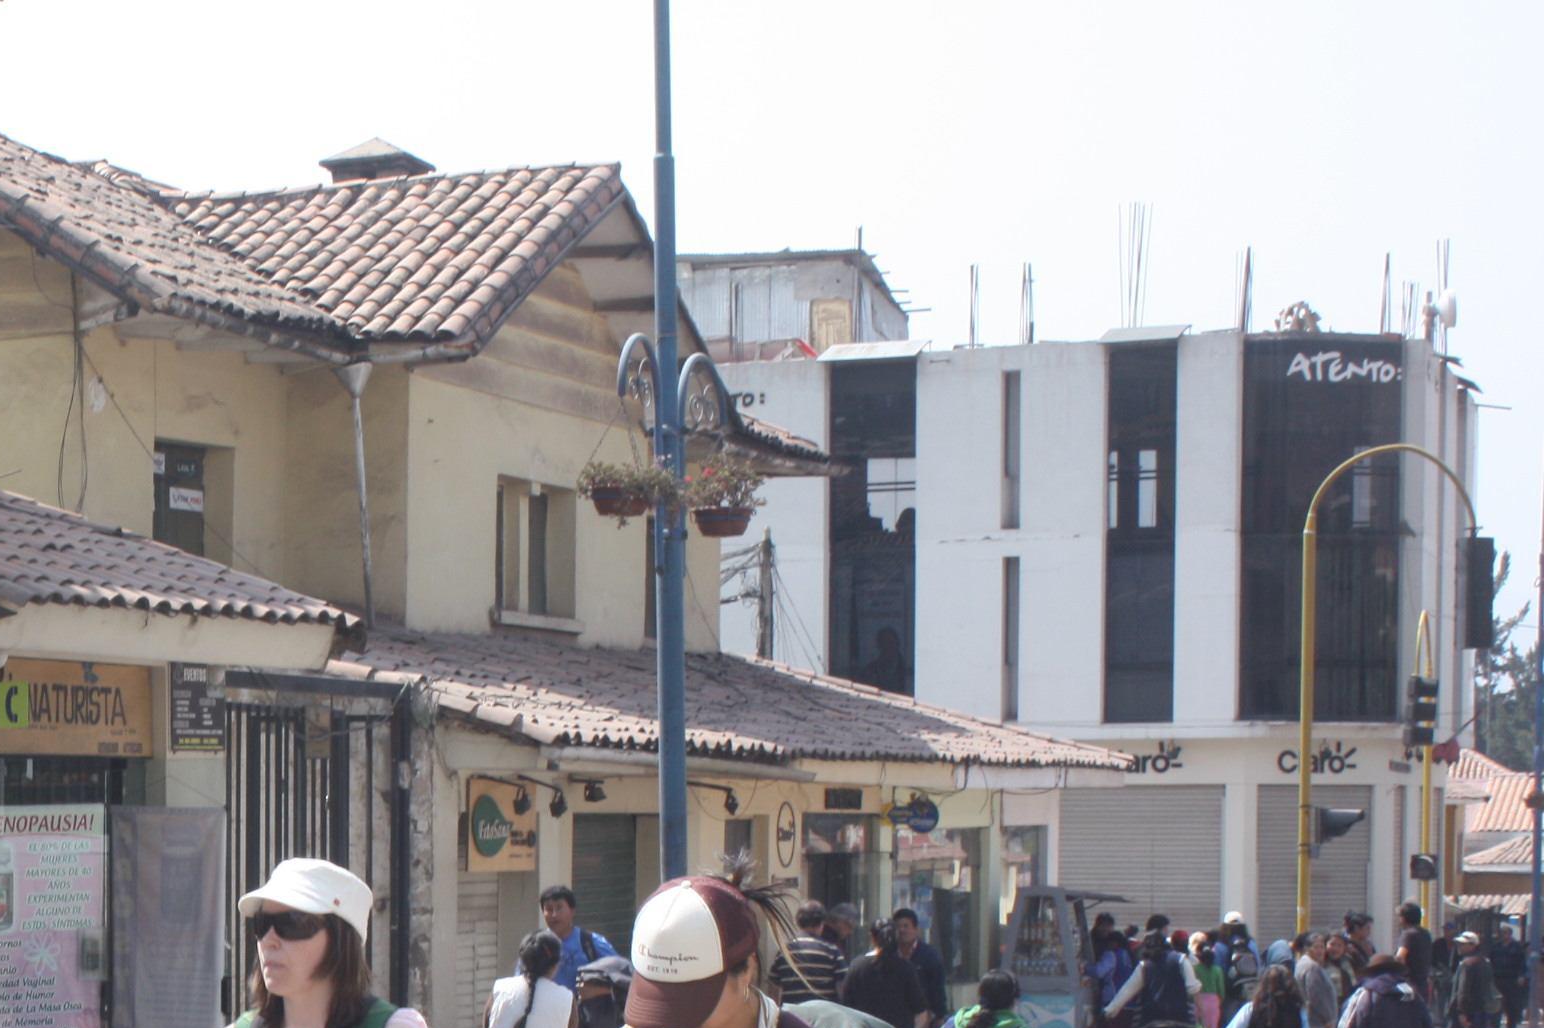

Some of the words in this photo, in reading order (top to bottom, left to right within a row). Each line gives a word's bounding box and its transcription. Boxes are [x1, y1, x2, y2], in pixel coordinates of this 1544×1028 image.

[28, 683, 127, 727] NATURISTA
[1277, 750, 1346, 773] Caro
[27, 892, 90, 905] EXPERIMENTAN
[23, 976, 56, 989] Vaginal
[13, 992, 22, 1001] de
[25, 990, 55, 1000] Humor
[12, 1005, 23, 1014] de
[15, 1017, 54, 1027] Memoria
